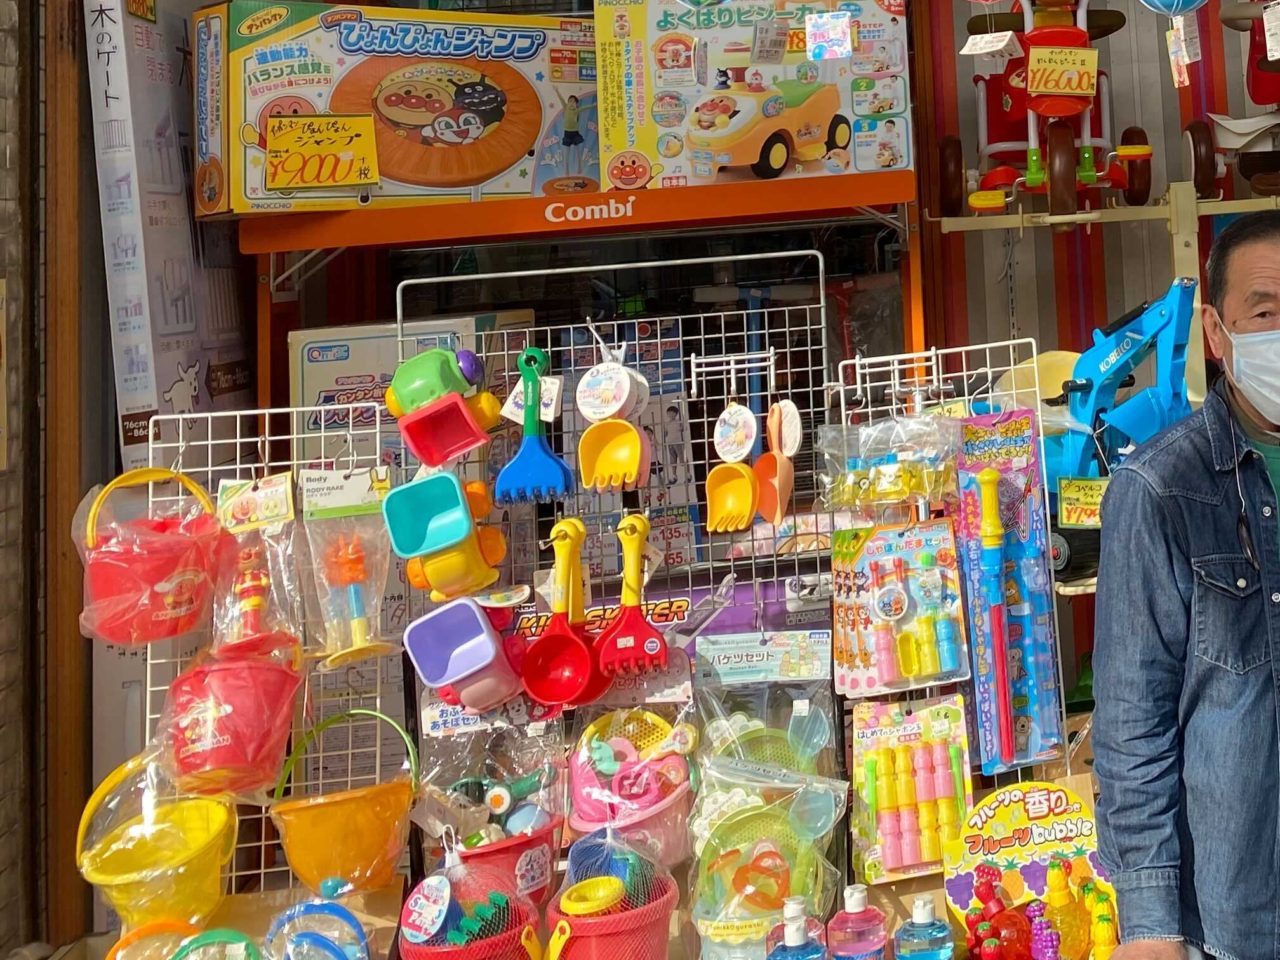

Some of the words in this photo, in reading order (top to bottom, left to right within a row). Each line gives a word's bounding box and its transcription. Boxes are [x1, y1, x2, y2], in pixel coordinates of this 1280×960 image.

[598, 0, 645, 7] PINOCCHIO
[341, 23, 545, 59] ぴょんぴょんジャンプ
[90, 4, 120, 108] 木のゲート
[251, 202, 292, 210] PINOCCHIO
[544, 196, 636, 223] Combi
[124, 420, 148, 429] 76cm
[866, 536, 950, 556] しゃぼんだまセット
[710, 651, 775, 666] バケツセット
[965, 826, 1032, 855] フルーツ
[1031, 816, 1094, 846] bubble
